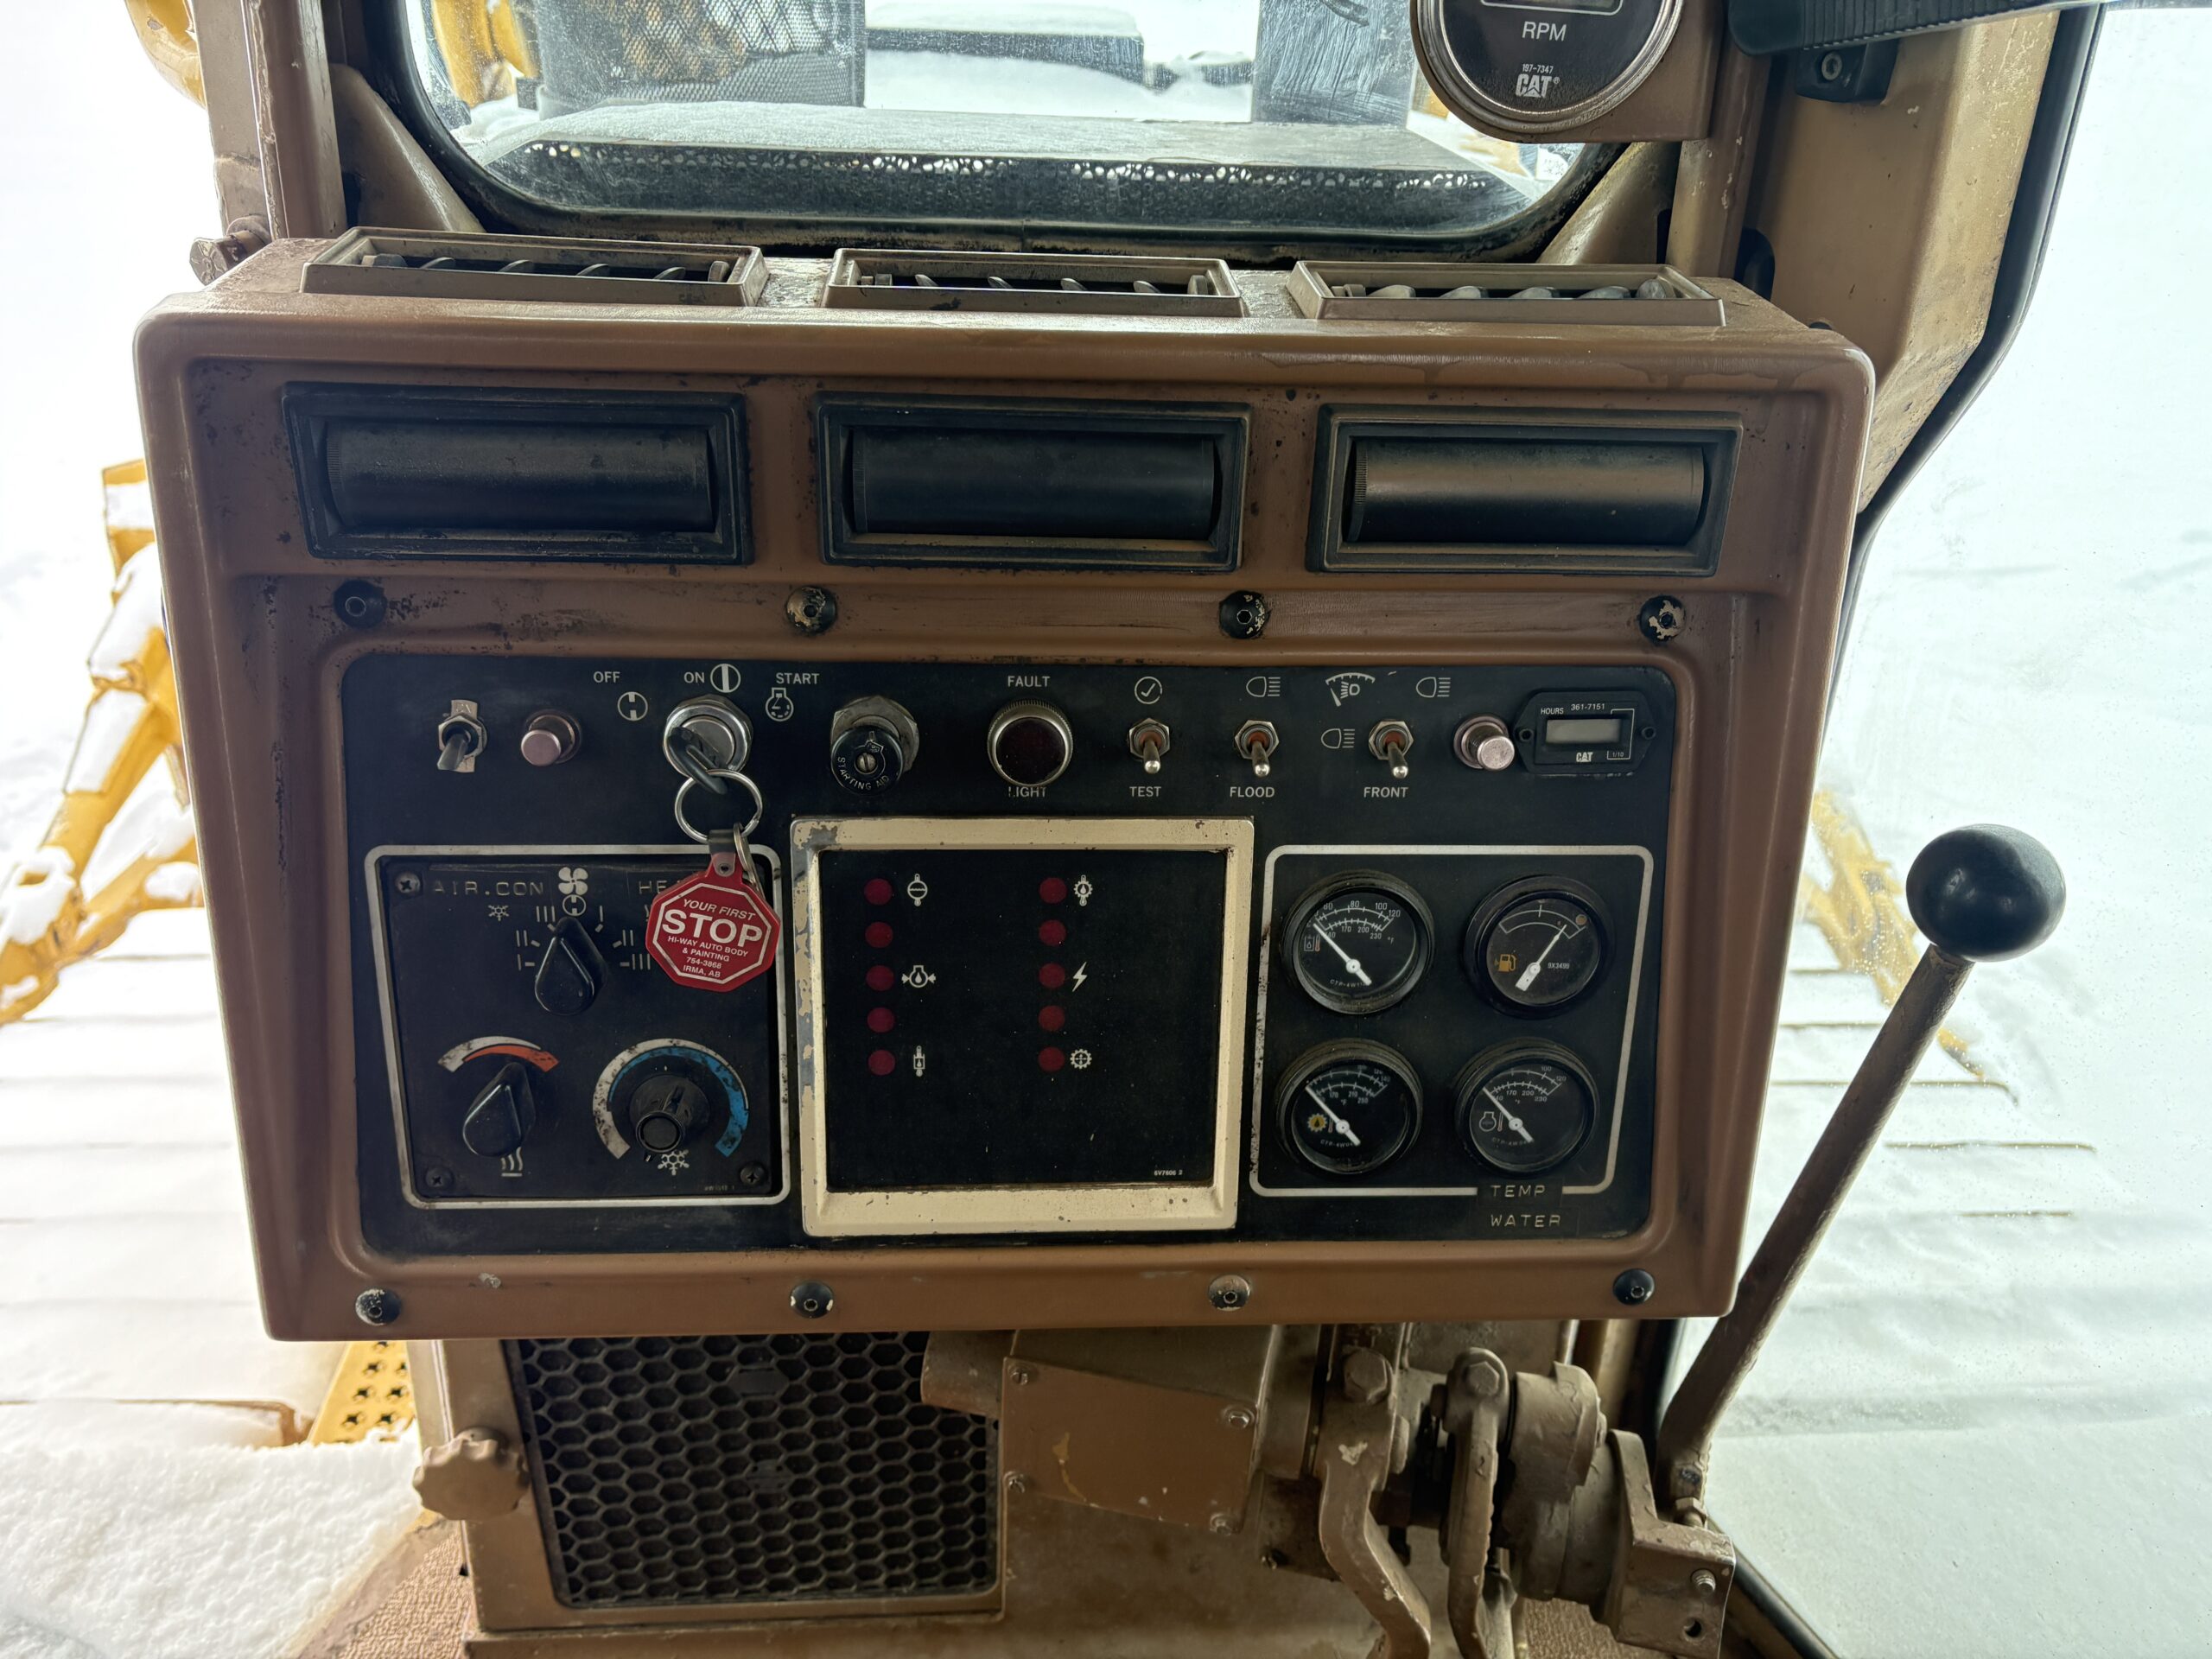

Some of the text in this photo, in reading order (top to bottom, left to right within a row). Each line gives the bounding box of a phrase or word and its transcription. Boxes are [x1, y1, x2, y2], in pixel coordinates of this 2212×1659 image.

[1522, 21, 1567, 41] RPM
[1522, 63, 1554, 73] 197-7347
[593, 671, 620, 683] OFF
[683, 671, 706, 684] ON
[775, 672, 820, 685] START
[1007, 675, 1051, 689] FAULT
[1575, 751, 1594, 763] CAT
[837, 756, 890, 791] STARTING AID
[1007, 786, 1047, 798] LIGHT
[1129, 786, 1162, 798] TEST
[1229, 786, 1275, 799] FLOOD
[1363, 786, 1409, 799] FRONT
[683, 899, 756, 921] YOUR FIRST
[662, 909, 763, 948] STOP
[667, 935, 749, 957] HI-WAY AUTO BODY
[690, 949, 730, 963] PAINTING
[686, 957, 722, 969] 754-3868
[709, 969, 721, 978] AB
[1490, 1185, 1546, 1198] TEMP
[1491, 1214, 1560, 1228] WATER
